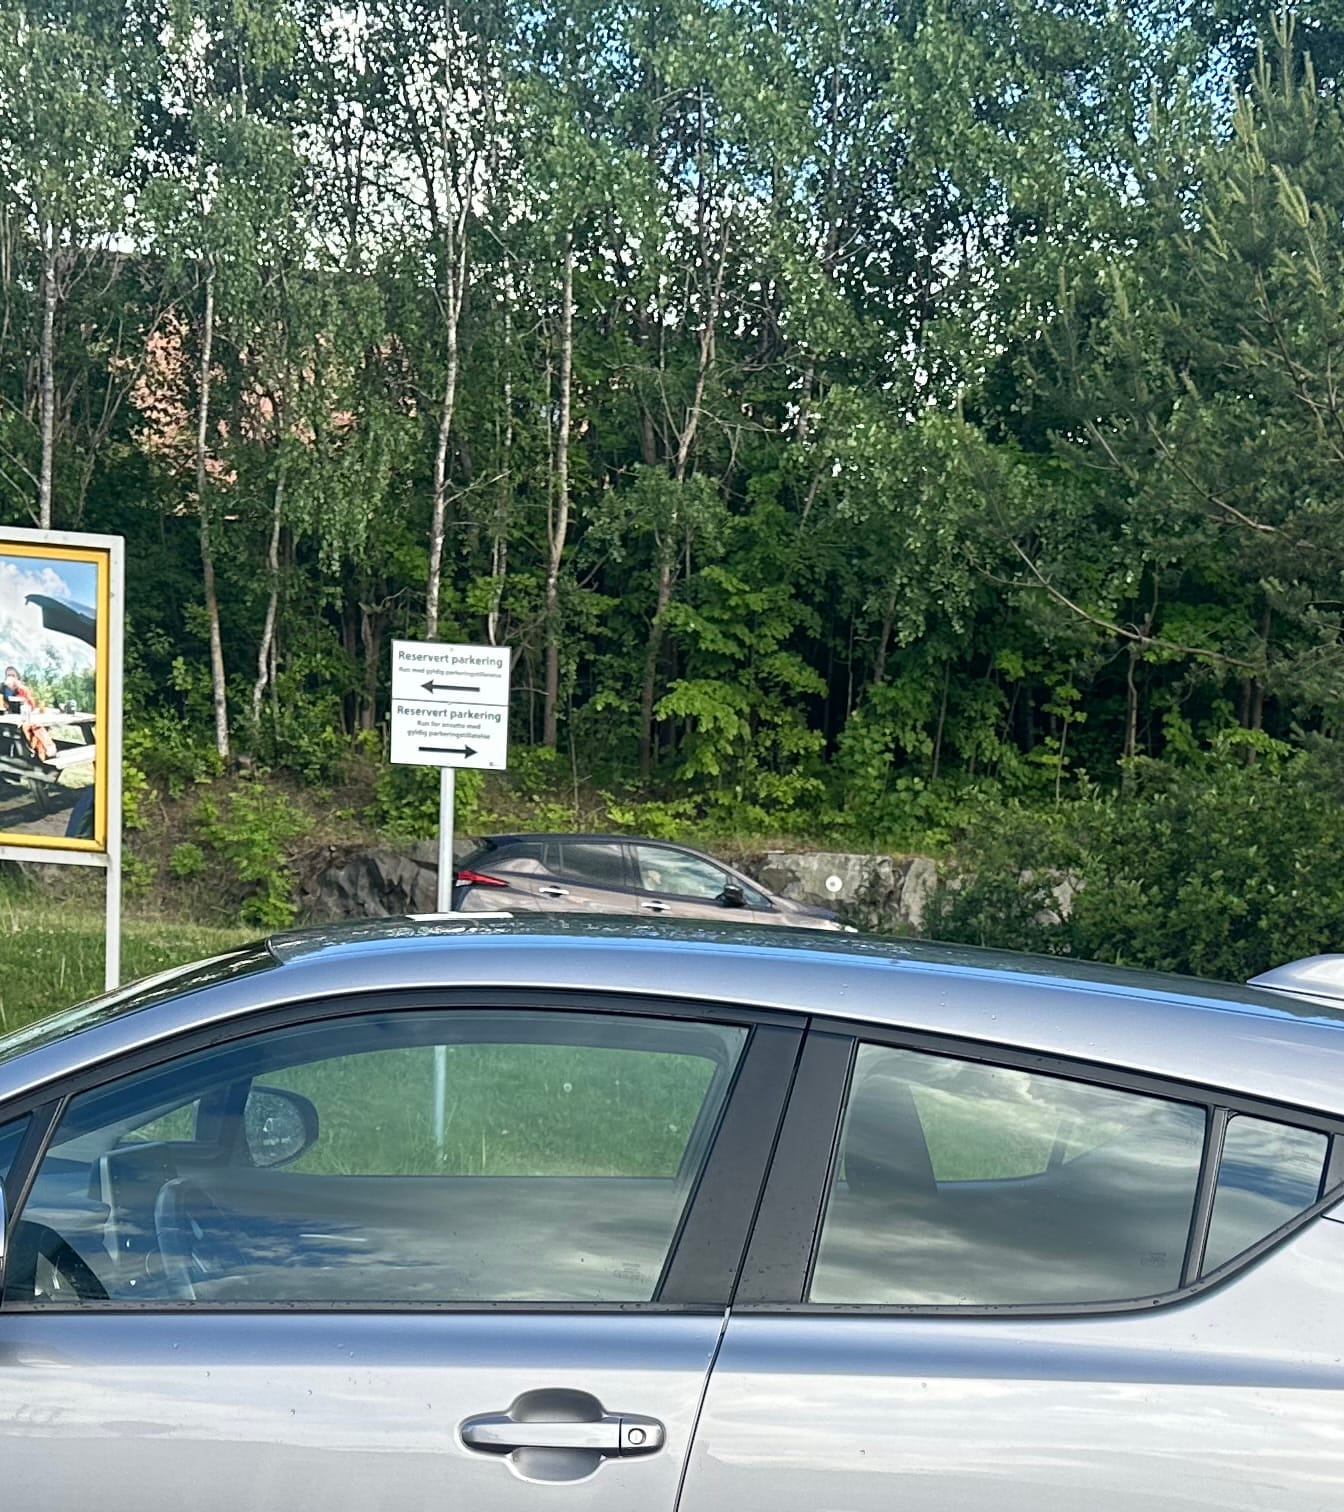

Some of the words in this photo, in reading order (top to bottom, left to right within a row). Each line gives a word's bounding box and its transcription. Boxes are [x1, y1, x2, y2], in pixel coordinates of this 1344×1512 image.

[398, 650, 449, 663] Reservert
[451, 655, 503, 669] parkering
[397, 705, 447, 717] Reservert
[450, 709, 502, 723] parkering
